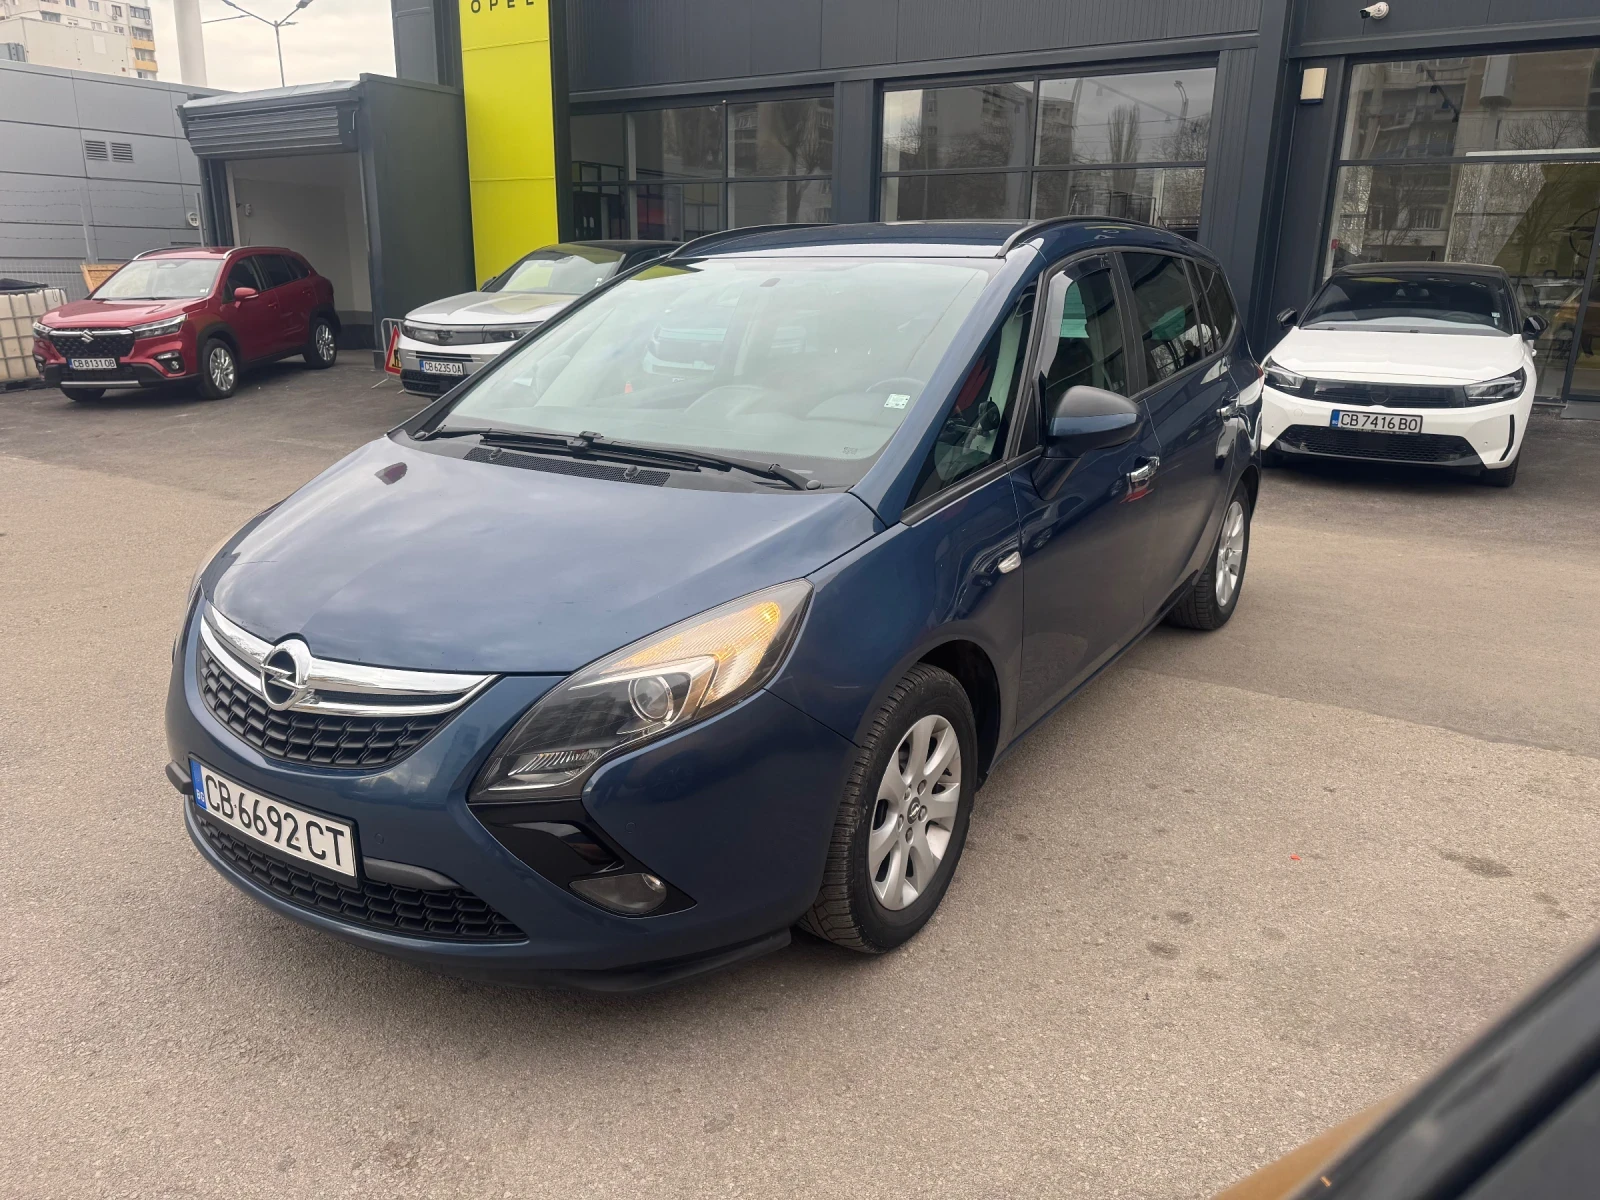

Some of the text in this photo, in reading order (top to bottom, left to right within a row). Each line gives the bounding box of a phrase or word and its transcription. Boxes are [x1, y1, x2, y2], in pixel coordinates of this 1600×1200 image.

[73, 359, 84, 368] CB
[85, 359, 103, 368] 8131
[424, 361, 433, 372] CB
[434, 362, 451, 373] 6235
[1340, 413, 1418, 431] CB 7416 BO
[205, 774, 345, 867] CB 6692 CT
